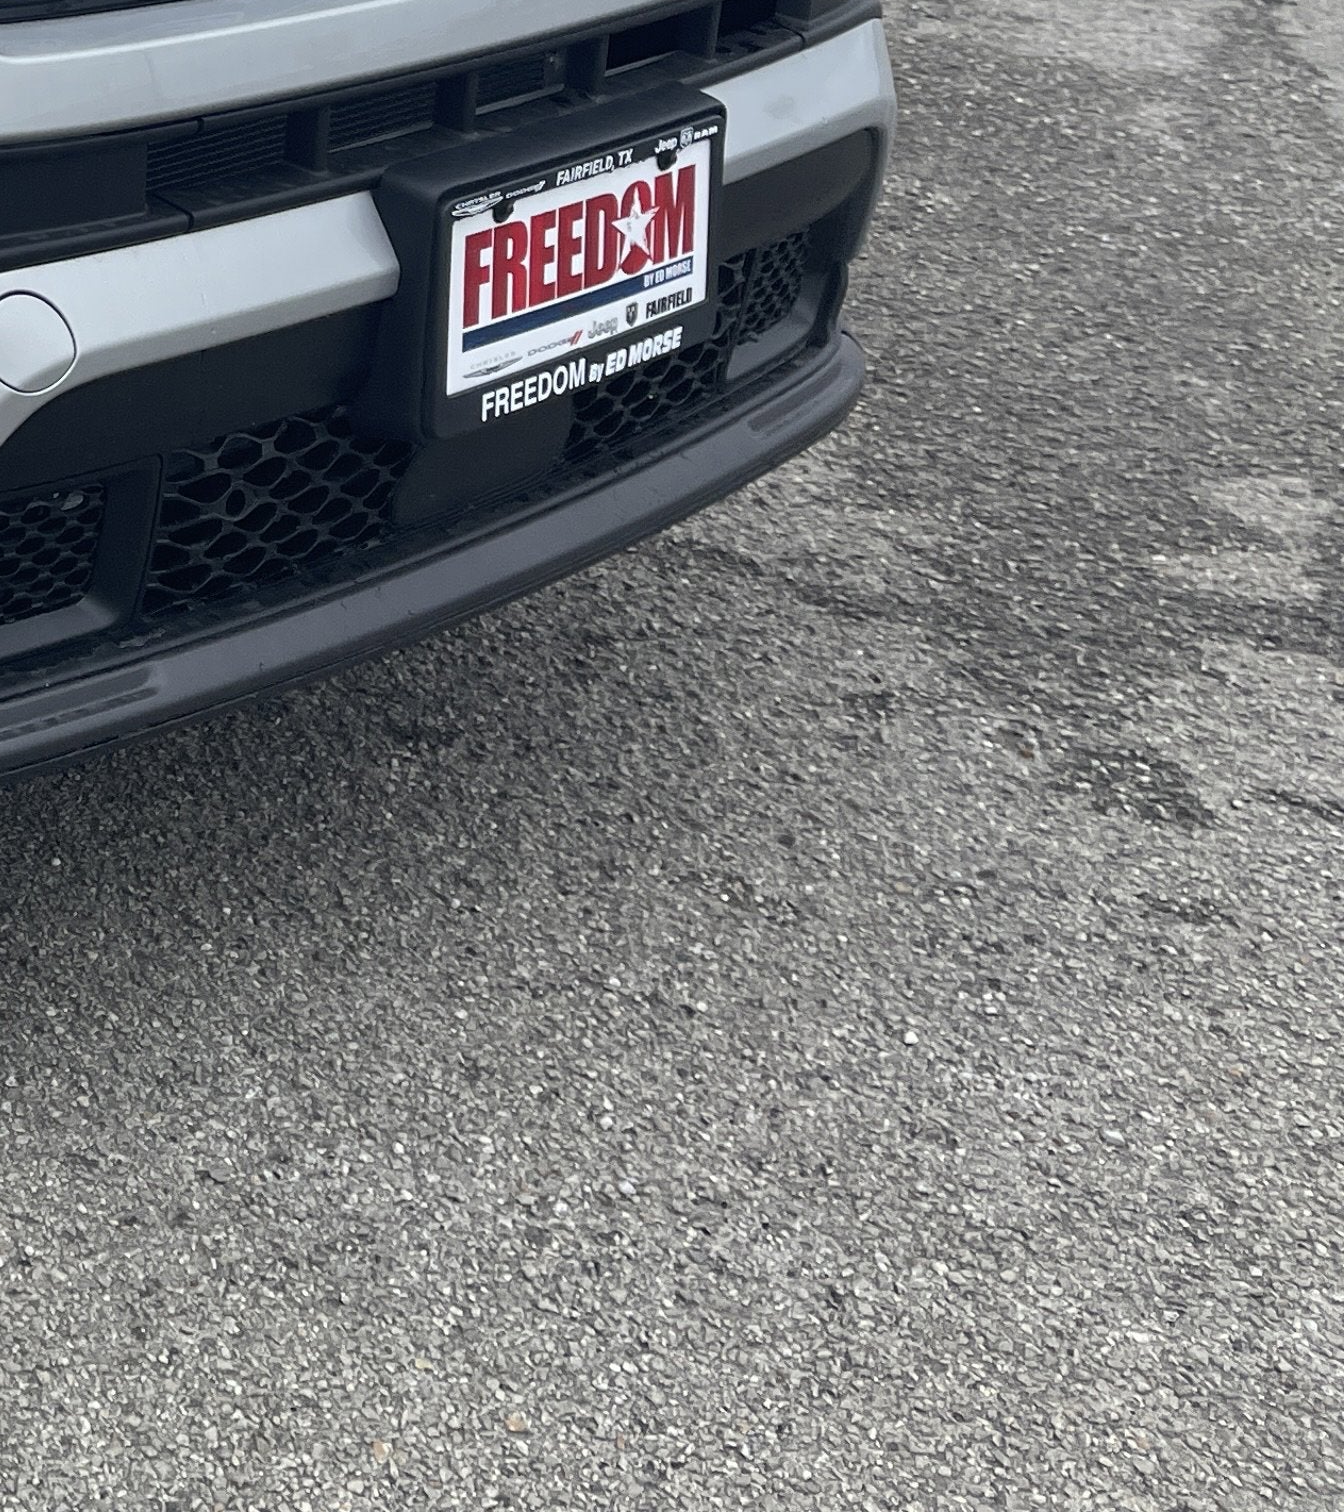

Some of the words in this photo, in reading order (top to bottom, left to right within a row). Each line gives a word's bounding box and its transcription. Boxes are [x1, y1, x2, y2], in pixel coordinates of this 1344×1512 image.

[556, 155, 615, 186] FAIRFIELD,
[618, 148, 633, 167] TX
[694, 125, 719, 140] RAM
[462, 164, 697, 329] FREEDOM
[587, 317, 619, 339] Jeep
[646, 287, 693, 319] FAIRFIELD
[481, 357, 587, 423] FREEDOM
[605, 348, 627, 377] ED
[627, 326, 684, 368] MORSE
